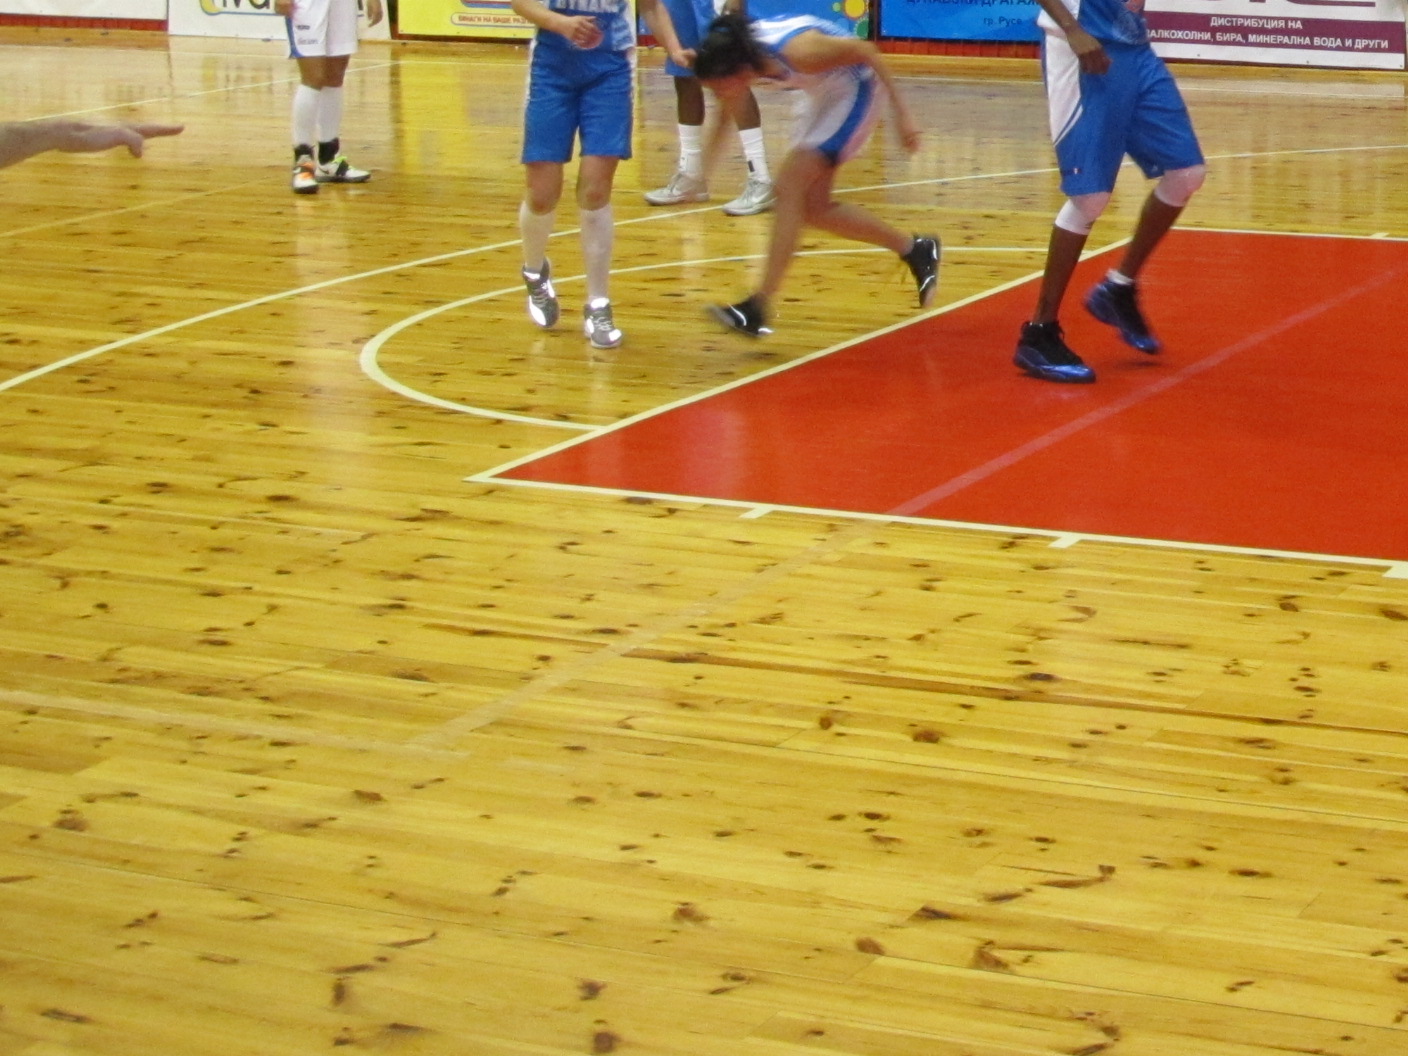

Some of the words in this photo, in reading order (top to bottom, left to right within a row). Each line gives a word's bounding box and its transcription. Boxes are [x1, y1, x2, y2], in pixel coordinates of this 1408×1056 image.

[999, 16, 1023, 27] Русе
[1210, 17, 1286, 29] ДИСТРИБУЦИЯ
[1288, 20, 1303, 29] НА
[1216, 32, 1246, 43] БИРА,
[1248, 33, 1311, 46] МИНЕРАЛНА
[1314, 36, 1342, 48] ВОДА
[1345, 38, 1353, 47] И
[1354, 38, 1389, 49] ДРУГИ
